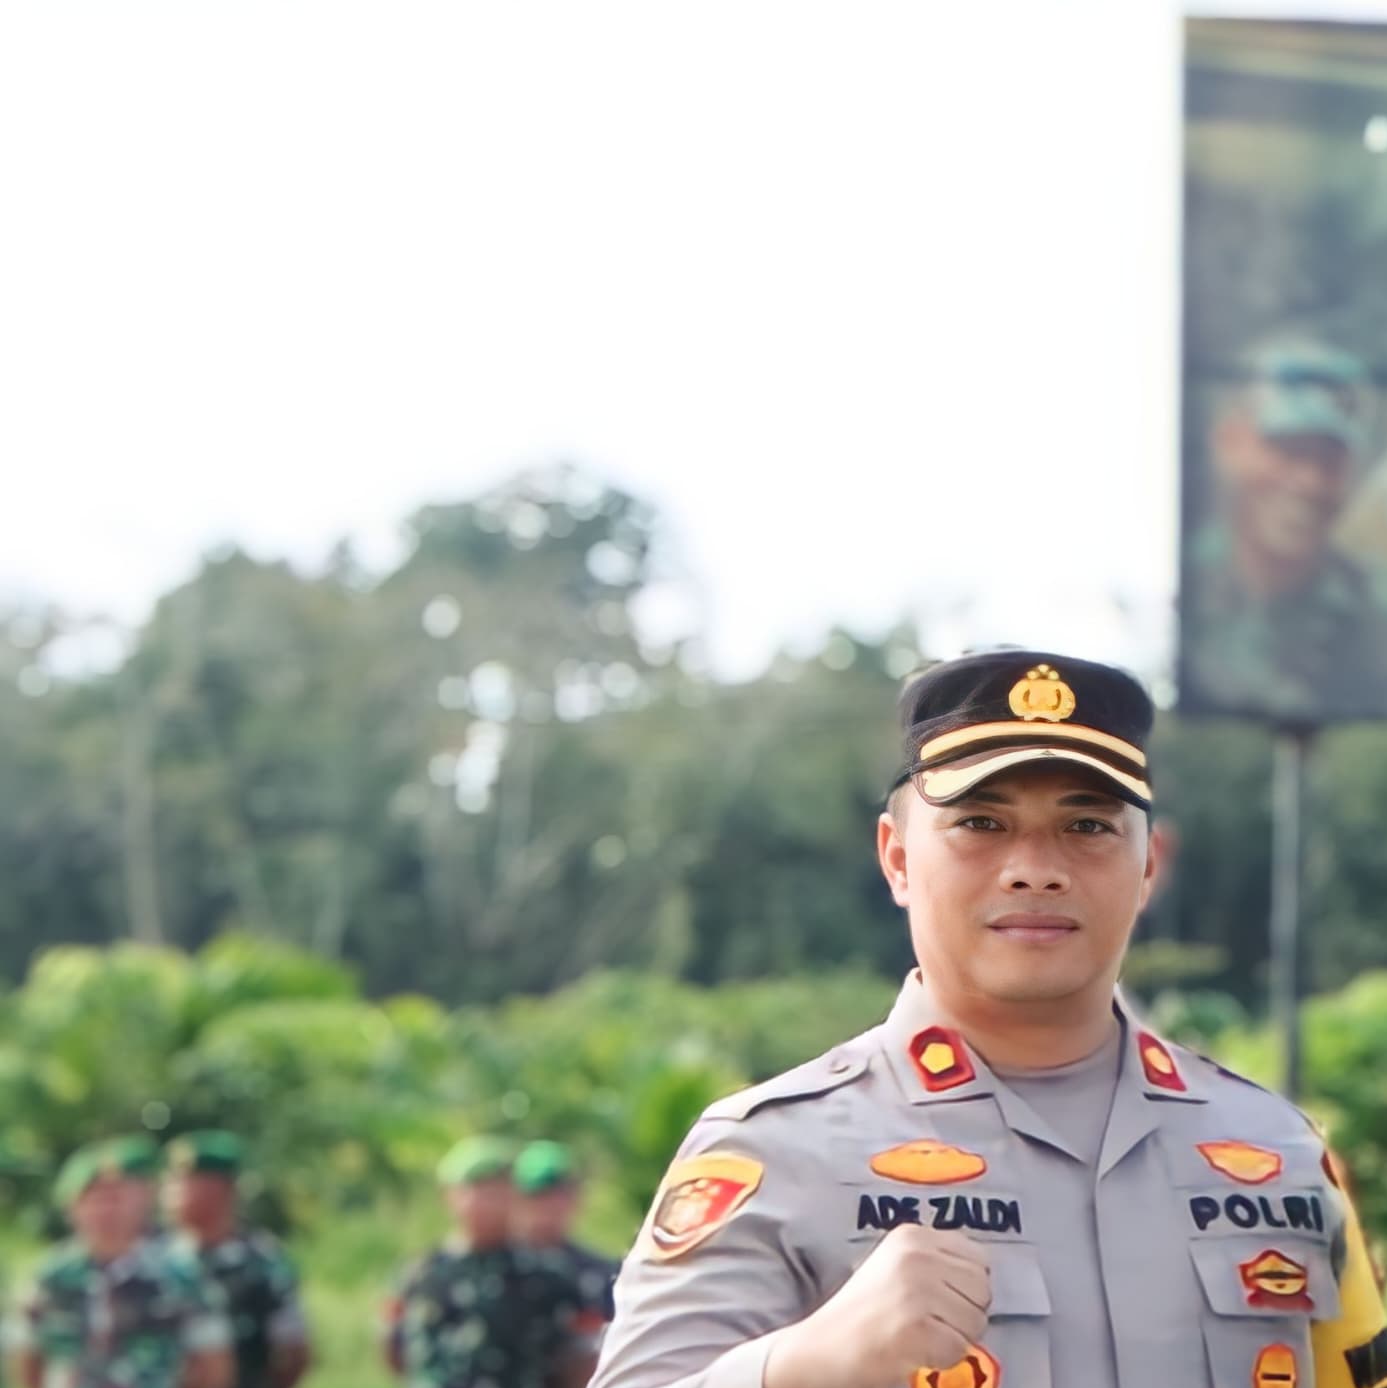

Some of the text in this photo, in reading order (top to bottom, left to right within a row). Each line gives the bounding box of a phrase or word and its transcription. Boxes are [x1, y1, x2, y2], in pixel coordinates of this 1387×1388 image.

[857, 1194, 1022, 1234] ADE ZALDI
[1189, 1194, 1324, 1232] POLRI
